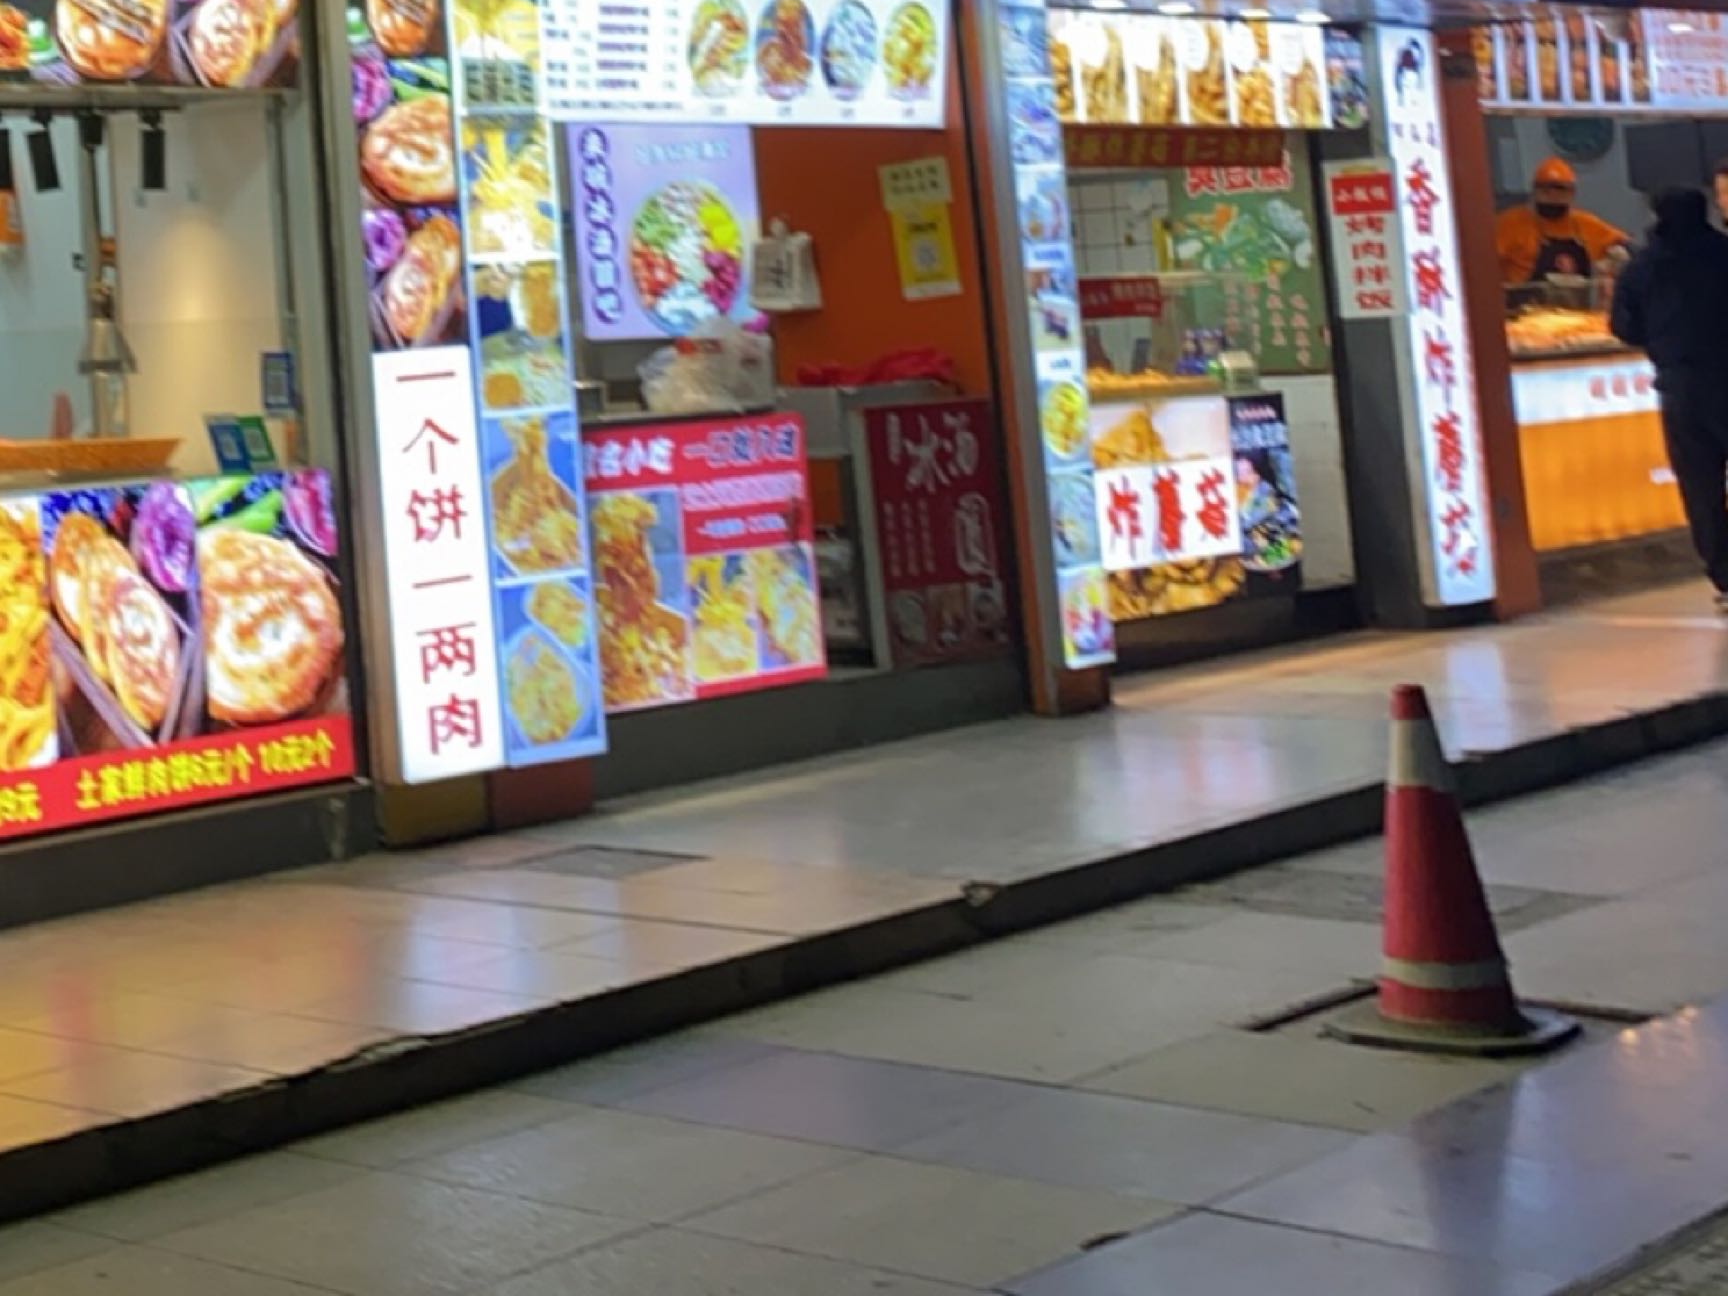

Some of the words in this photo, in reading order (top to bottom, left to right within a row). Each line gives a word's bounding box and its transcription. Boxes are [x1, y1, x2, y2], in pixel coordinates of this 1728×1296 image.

[1106, 467, 1230, 561] 炸蘑菇
[1404, 156, 1478, 578] 香酥炸蘑菇
[396, 371, 483, 755] 一个饼一两肉
